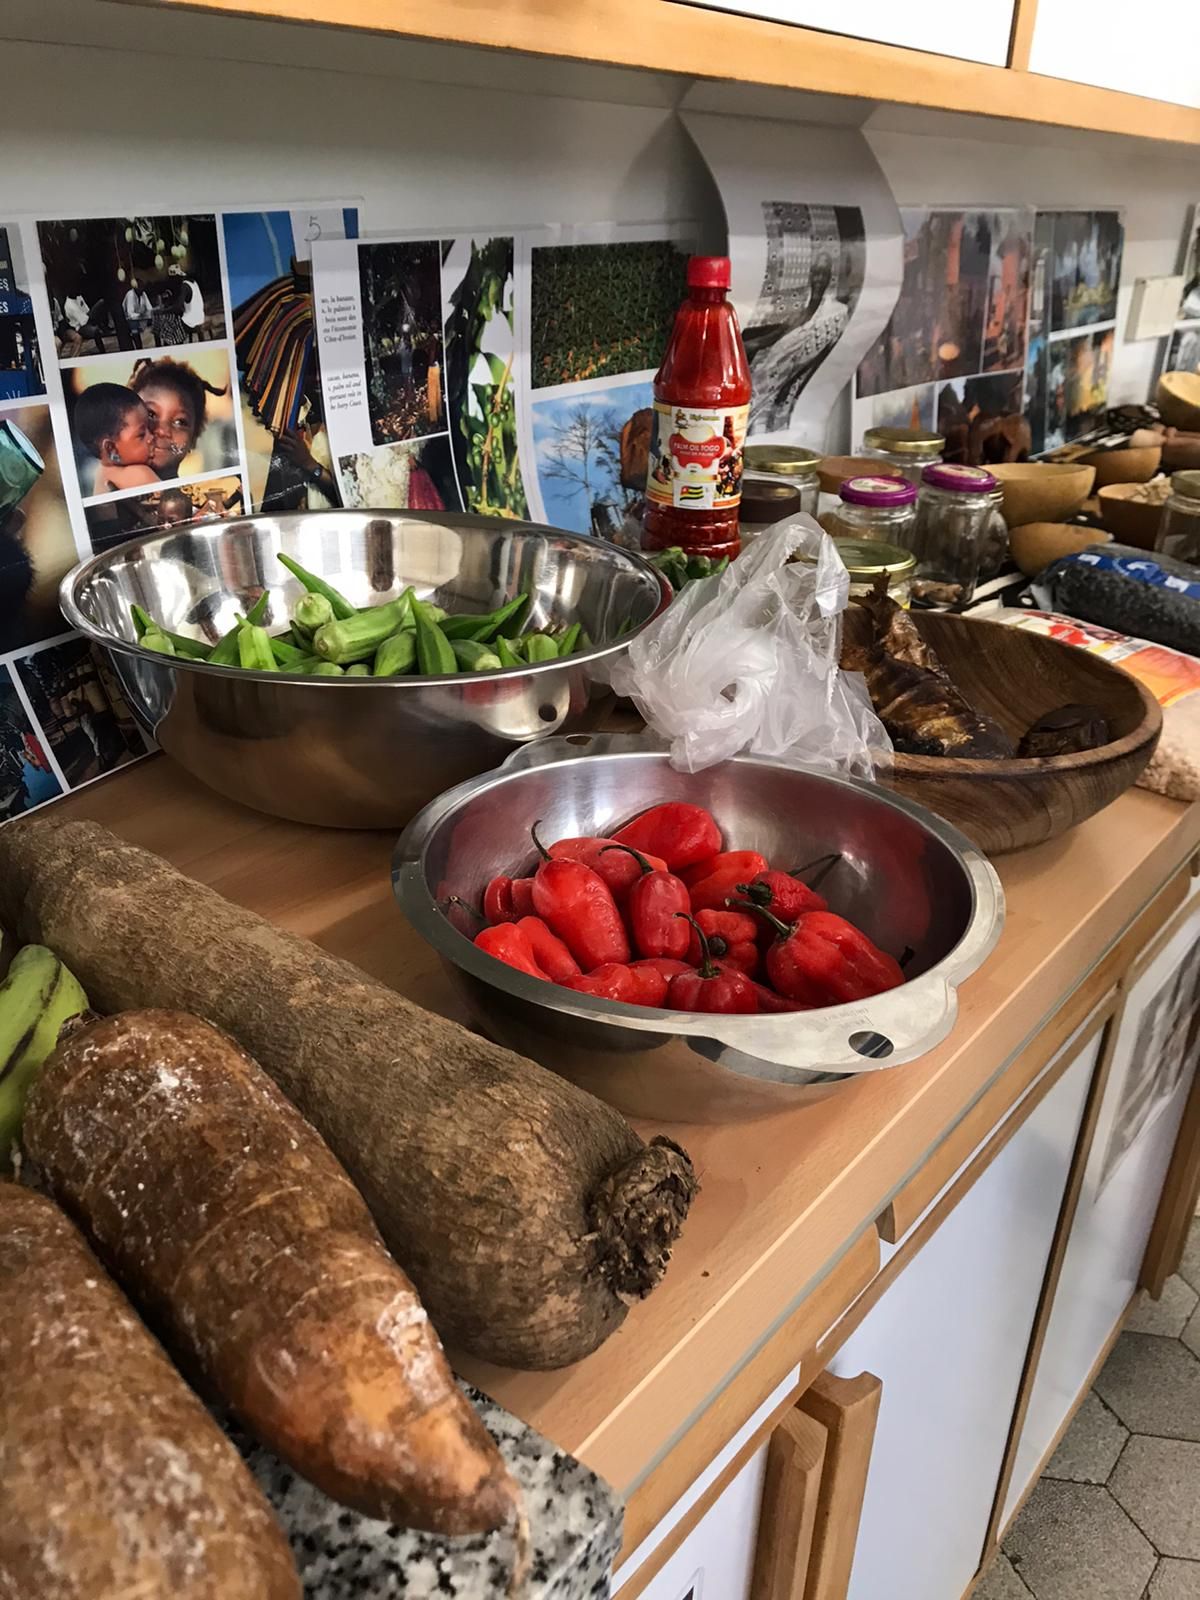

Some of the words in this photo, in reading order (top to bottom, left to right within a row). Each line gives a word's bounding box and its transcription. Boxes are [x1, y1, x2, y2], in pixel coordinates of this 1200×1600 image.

[303, 216, 321, 242] 5
[674, 442, 689, 450] PALM
[689, 444, 700, 452] OIL
